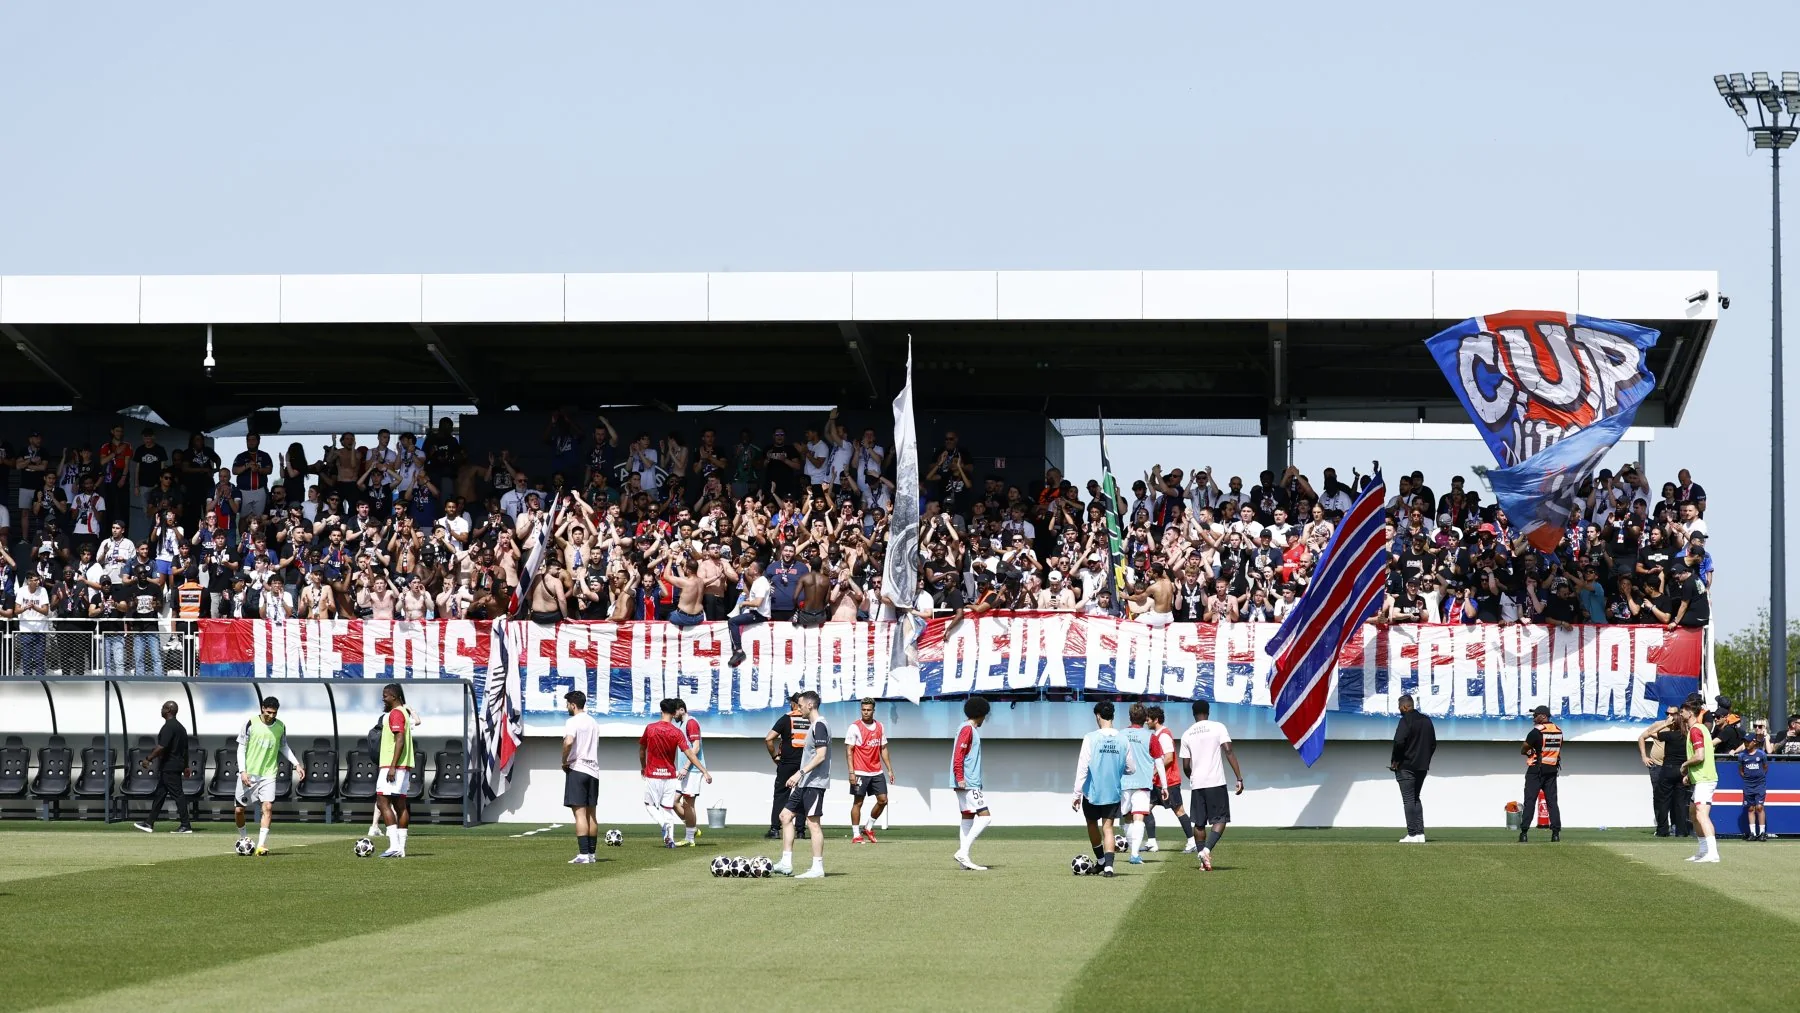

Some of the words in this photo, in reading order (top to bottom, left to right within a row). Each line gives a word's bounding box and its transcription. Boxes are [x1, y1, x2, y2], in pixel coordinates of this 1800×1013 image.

[1457, 321, 1642, 428] CUP
[252, 620, 348, 679] UNE
[362, 620, 477, 679] FOIS
[632, 621, 926, 713] HISTORIQU
[941, 615, 1073, 694] DEUX
[1085, 618, 1199, 699] FOIS
[1363, 620, 1663, 718] LEGENDAIRE
